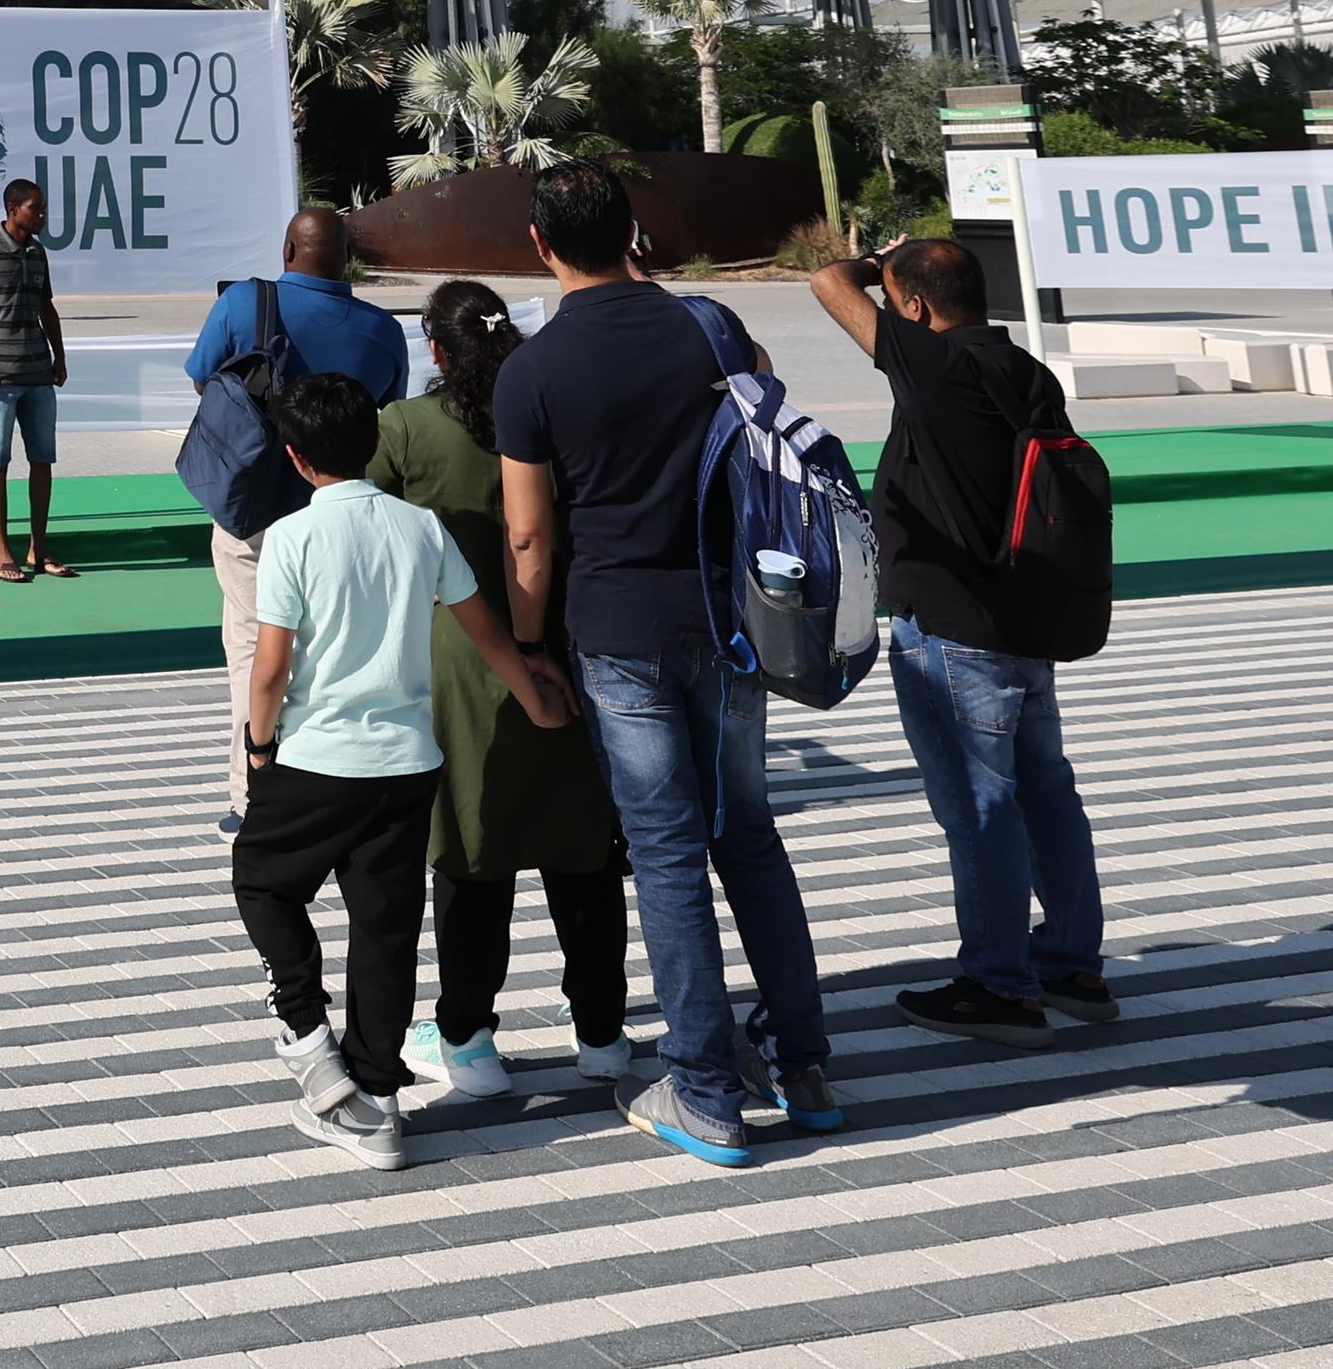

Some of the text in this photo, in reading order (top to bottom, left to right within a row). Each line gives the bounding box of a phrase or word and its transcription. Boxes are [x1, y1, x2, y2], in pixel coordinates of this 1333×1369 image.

[32, 50, 240, 146] COP28
[35, 155, 169, 251] UAE
[1058, 185, 1270, 255] HOPE
